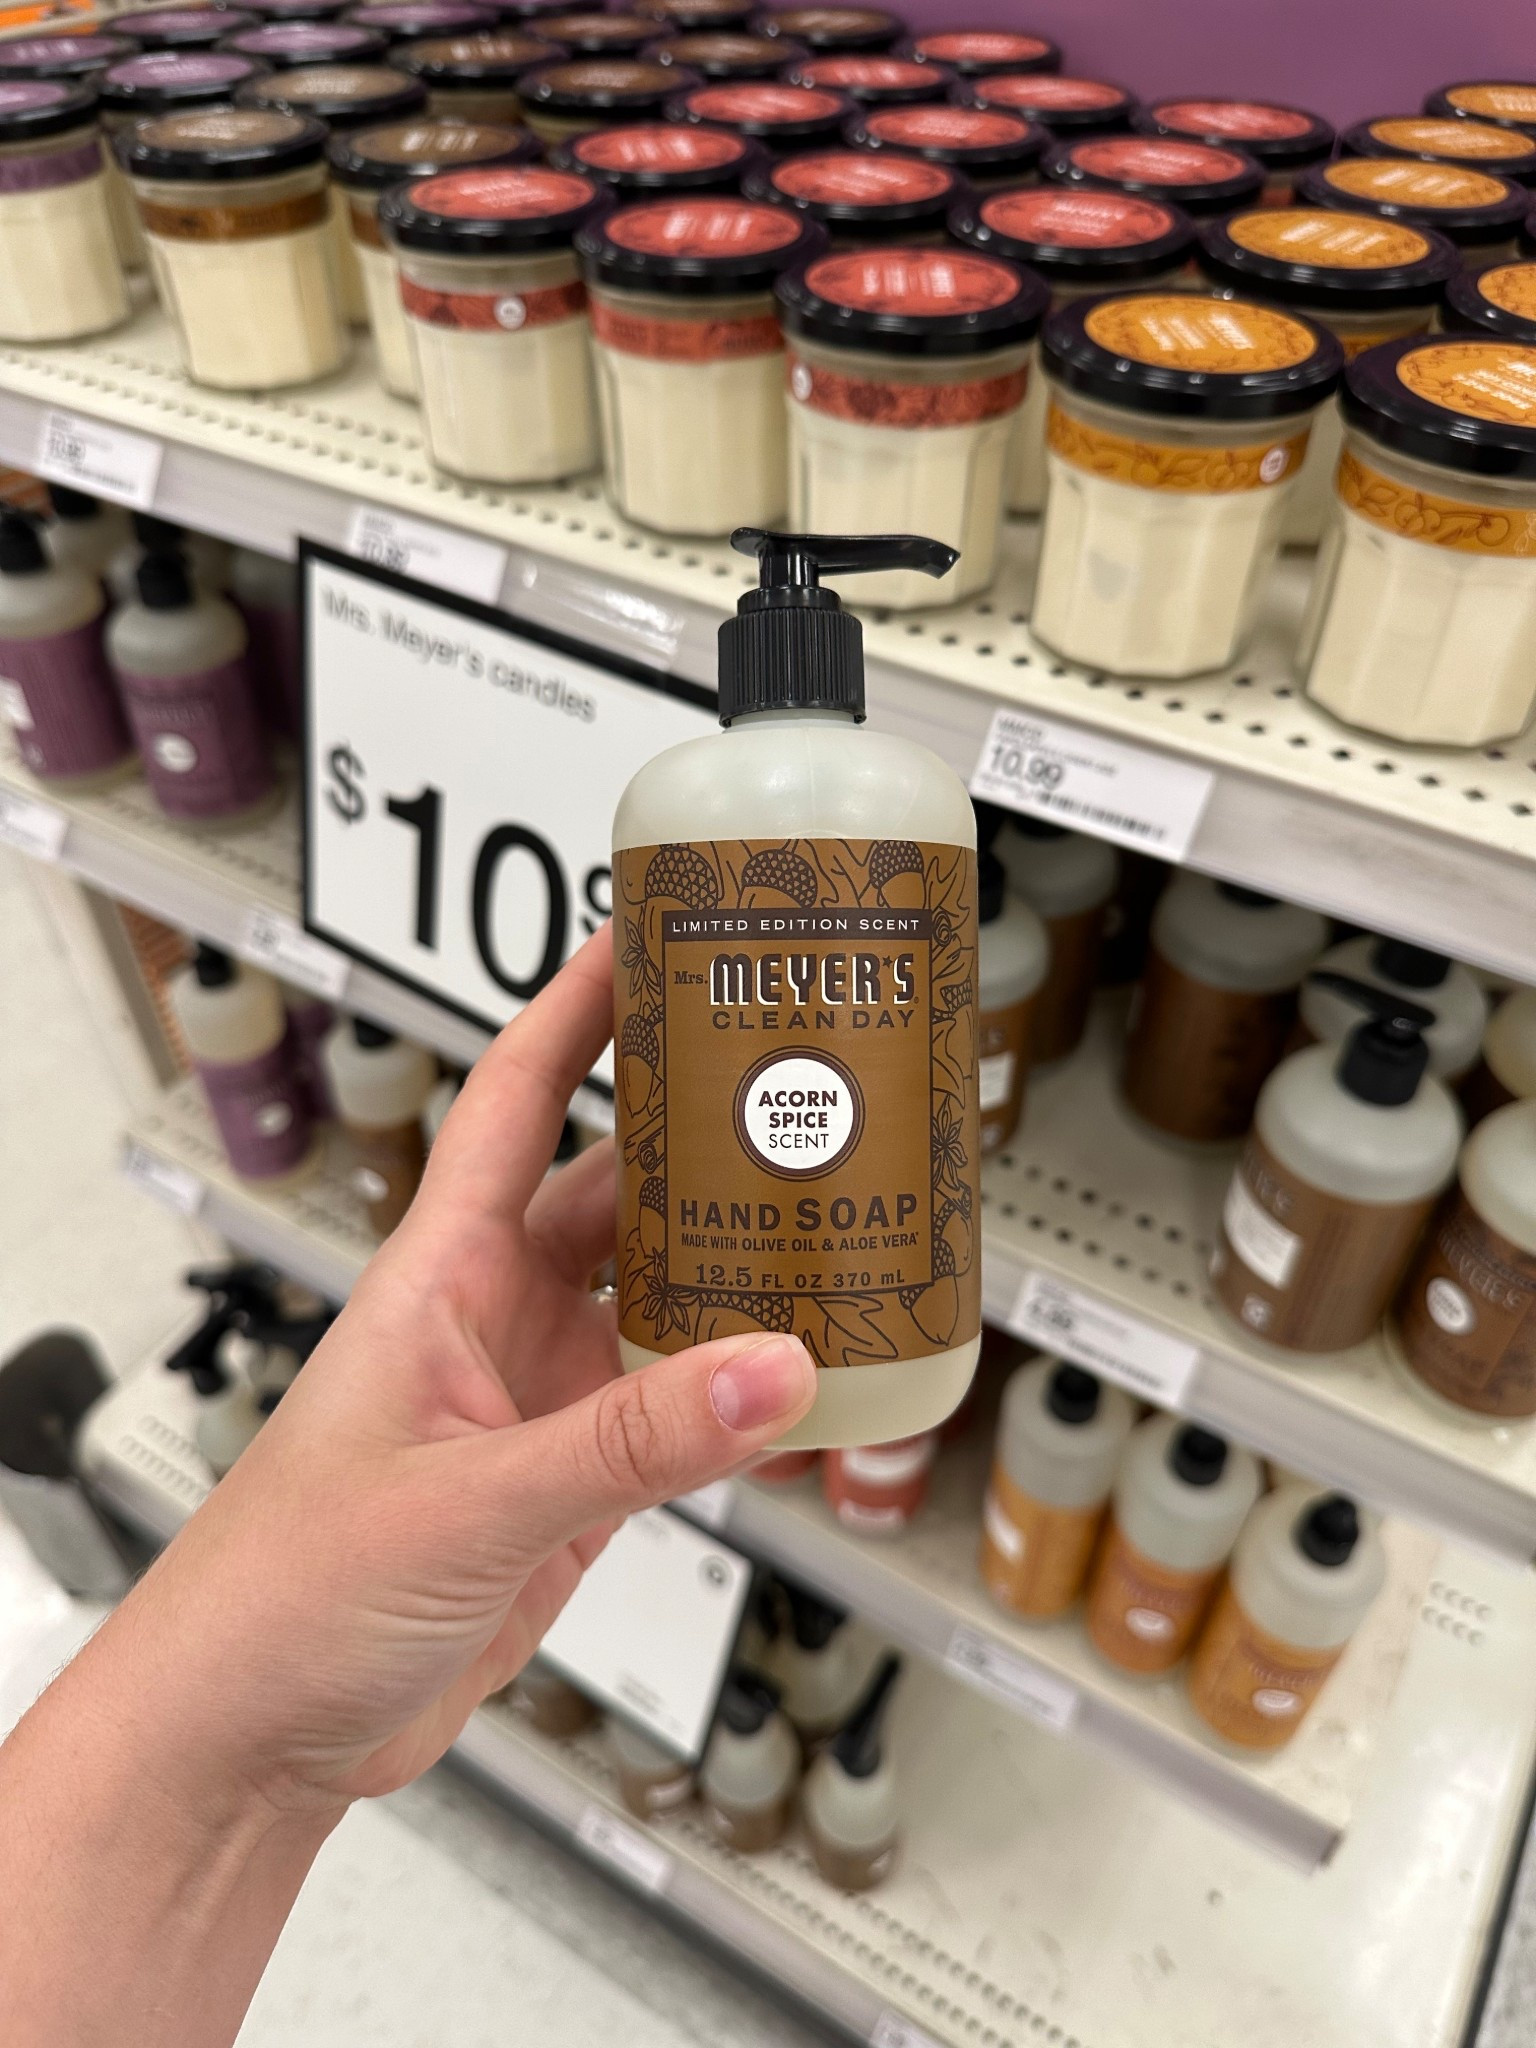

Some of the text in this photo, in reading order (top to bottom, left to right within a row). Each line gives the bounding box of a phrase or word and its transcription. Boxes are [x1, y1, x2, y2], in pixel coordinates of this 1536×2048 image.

[487, 654, 598, 723] candles
[672, 918, 920, 933] LIMITED EDITION SCENT
[673, 969, 709, 986] Mrs.
[711, 1009, 916, 1030] CLEAN DAY
[758, 1090, 839, 1108] ACORN
[768, 1111, 829, 1130] SPICE
[767, 1132, 831, 1150] SCENT
[680, 1193, 918, 1232] HAND SOAP
[680, 1232, 708, 1249] MADE
[710, 1235, 738, 1251] WITH
[741, 1237, 787, 1252] OLIVE
[791, 1238, 818, 1252] OIL
[821, 1237, 835, 1252] &
[838, 1235, 878, 1251] ALOE
[695, 1262, 906, 1289] 12.5 FL OZ 370 mL
